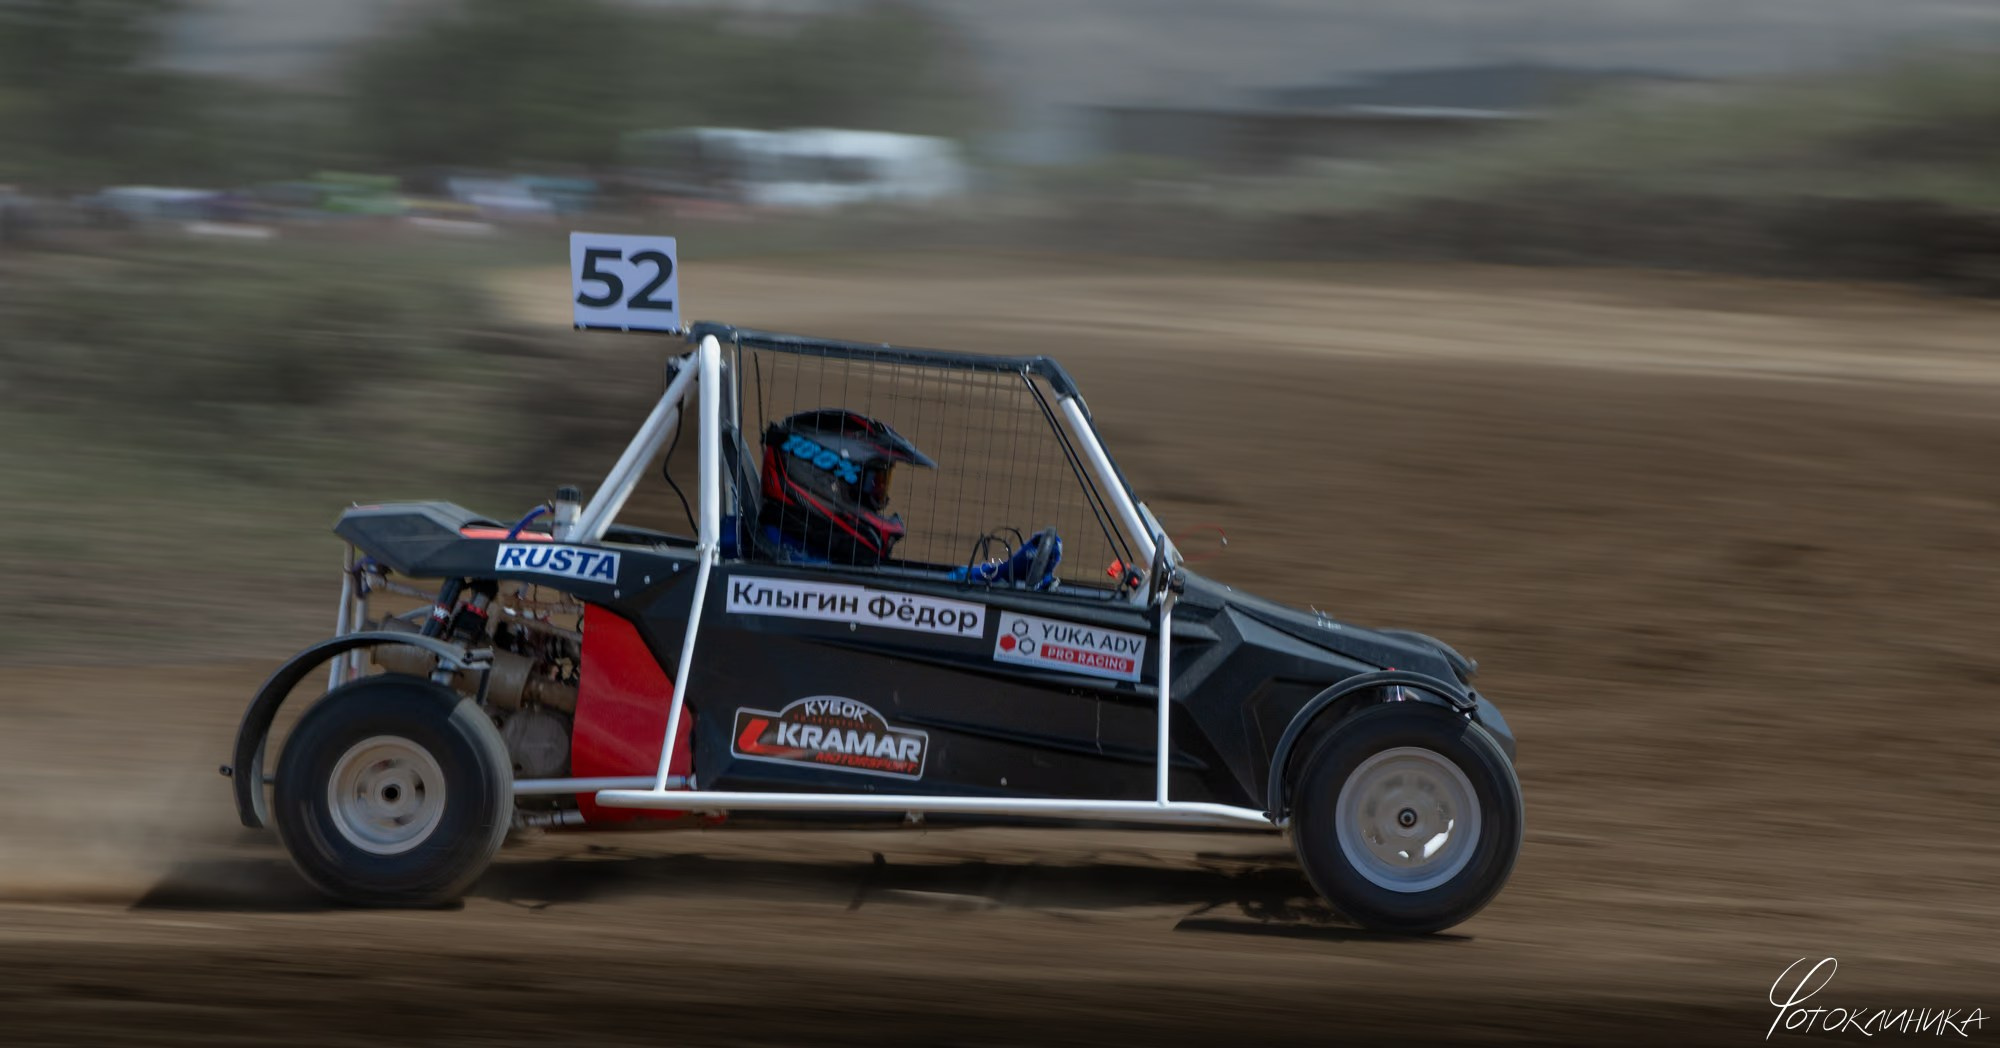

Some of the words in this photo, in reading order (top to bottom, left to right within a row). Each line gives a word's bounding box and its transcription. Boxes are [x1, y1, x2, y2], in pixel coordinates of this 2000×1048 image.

[575, 247, 673, 311] 52
[500, 547, 615, 580] RUSTA
[733, 582, 859, 614] Клыгин
[867, 595, 978, 633] Фёдор
[1042, 622, 1095, 648] YUKA
[1100, 634, 1142, 655] ADV
[1048, 648, 1074, 661] PRO
[1078, 653, 1128, 671] RACING
[804, 700, 868, 723] КУБОК
[776, 721, 922, 763] KRAMAR
